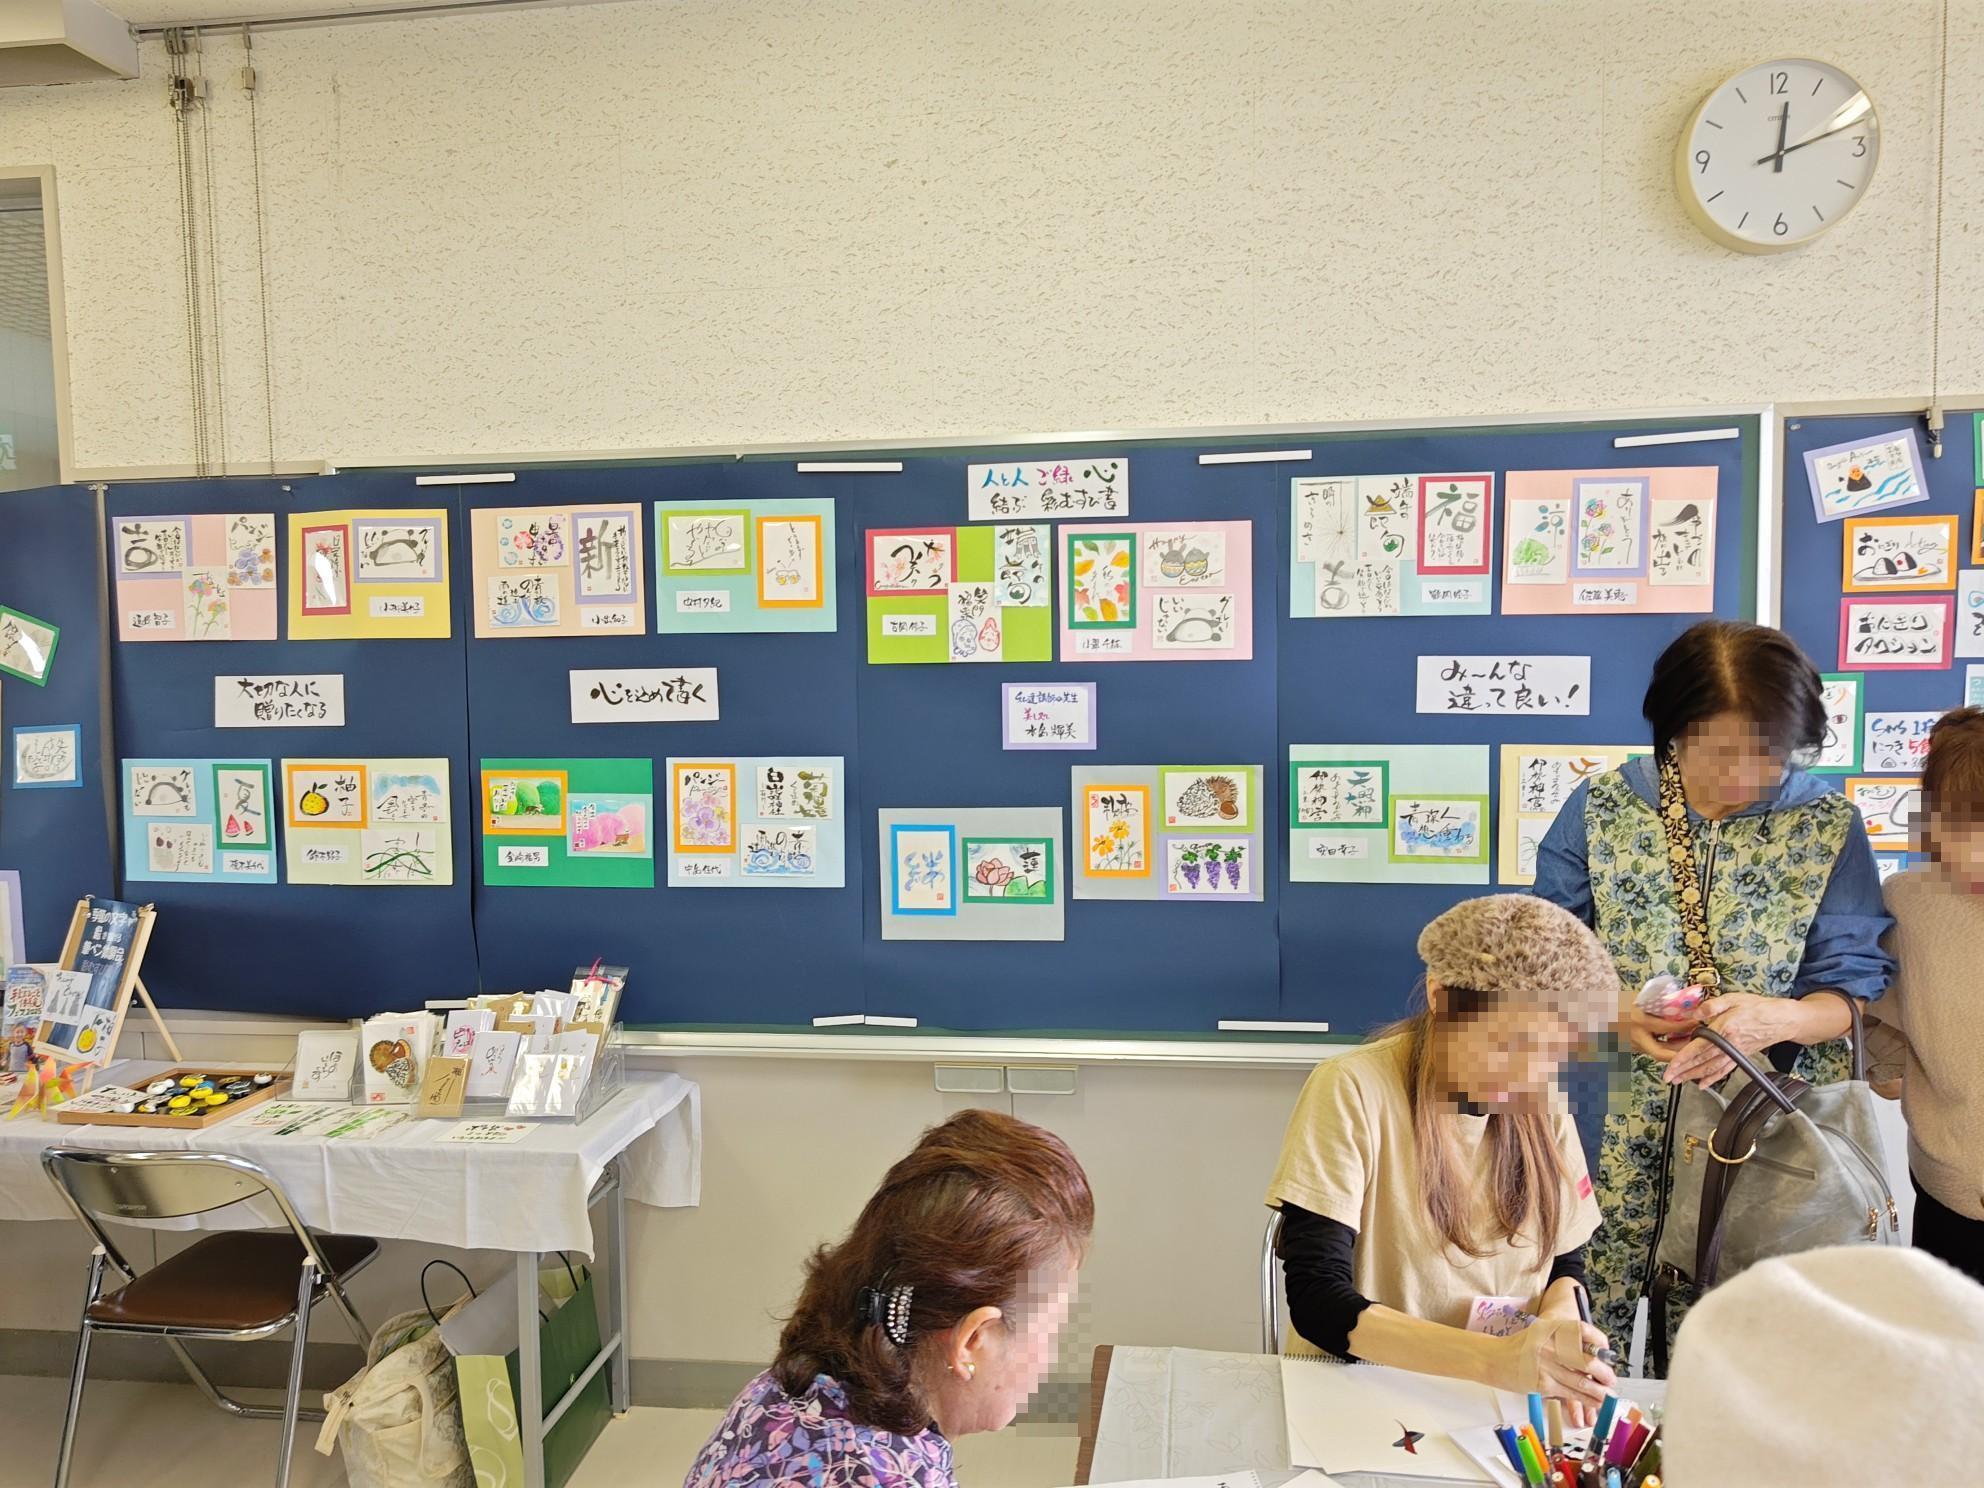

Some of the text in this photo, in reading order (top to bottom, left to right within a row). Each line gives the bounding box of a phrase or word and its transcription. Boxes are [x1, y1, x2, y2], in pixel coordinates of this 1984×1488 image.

[1770, 71, 1789, 95] 12
[1851, 136, 1866, 158] 3
[1695, 150, 1711, 174] 9
[1773, 212, 1788, 236] 6
[982, 467, 1029, 489] 人と人
[1083, 462, 1119, 483] 心
[991, 492, 1027, 515] 結ぶ
[1426, 484, 1480, 532] 福
[237, 680, 321, 699] 大切な人に
[254, 701, 327, 721] 贈りたくなる
[334, 775, 357, 817] 柚子
